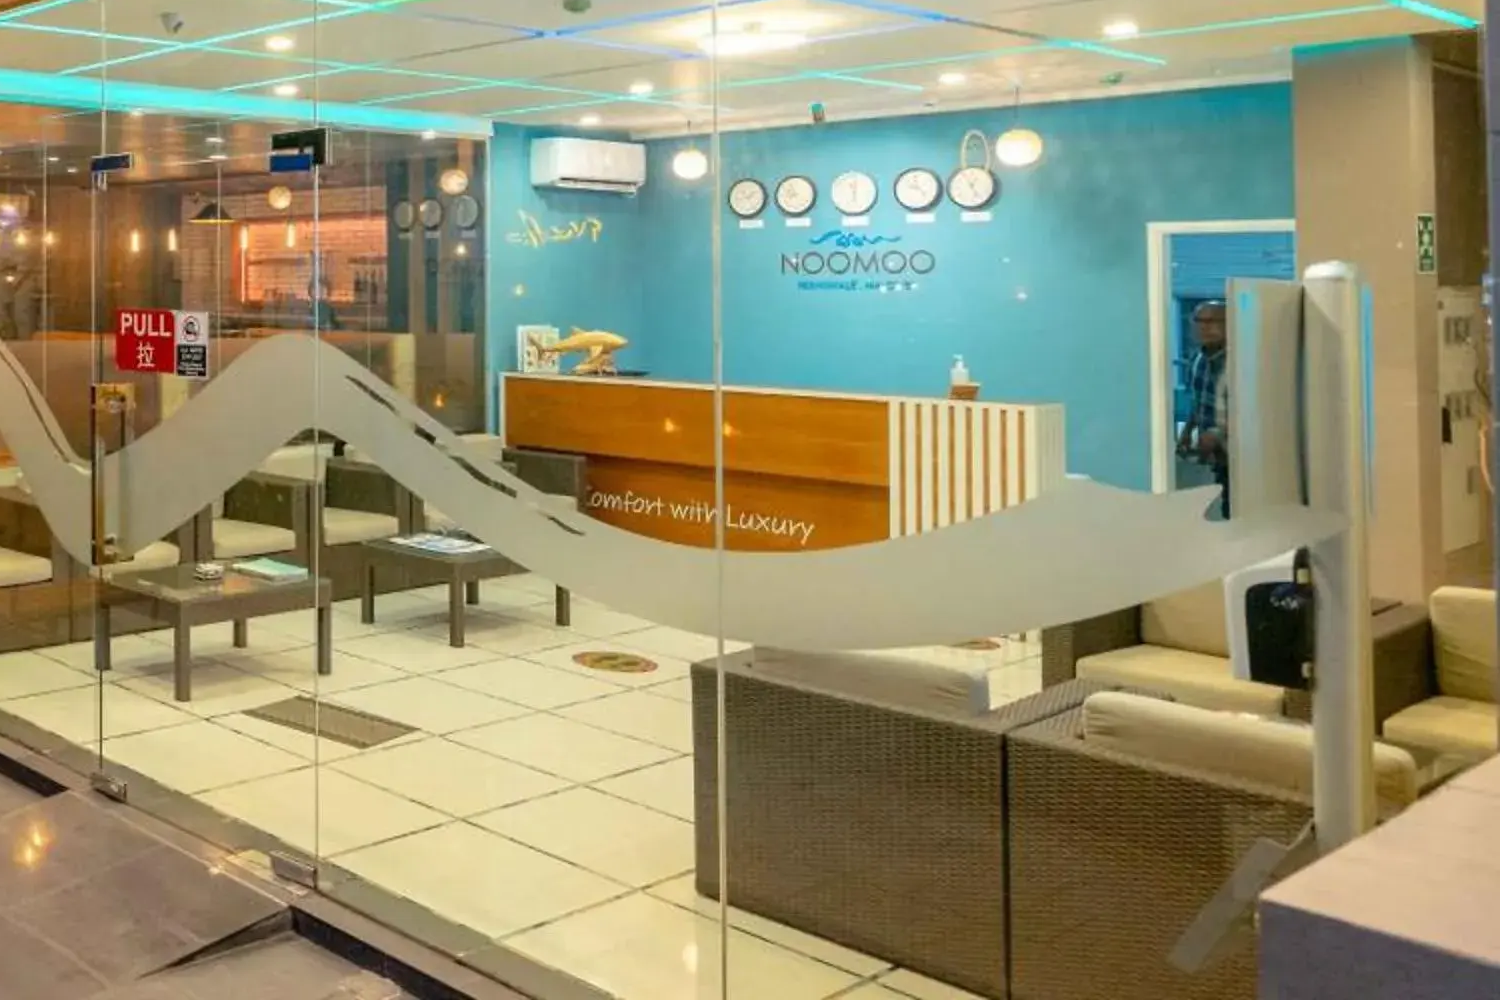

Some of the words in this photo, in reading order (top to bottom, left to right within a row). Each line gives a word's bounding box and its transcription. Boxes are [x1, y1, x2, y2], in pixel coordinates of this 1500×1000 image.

[781, 249, 936, 275] NOOMOO
[120, 312, 172, 337] PULL
[136, 341, 156, 368] 拉
[586, 485, 666, 516] omfort
[670, 500, 719, 524] with
[726, 504, 816, 546] Luxury
